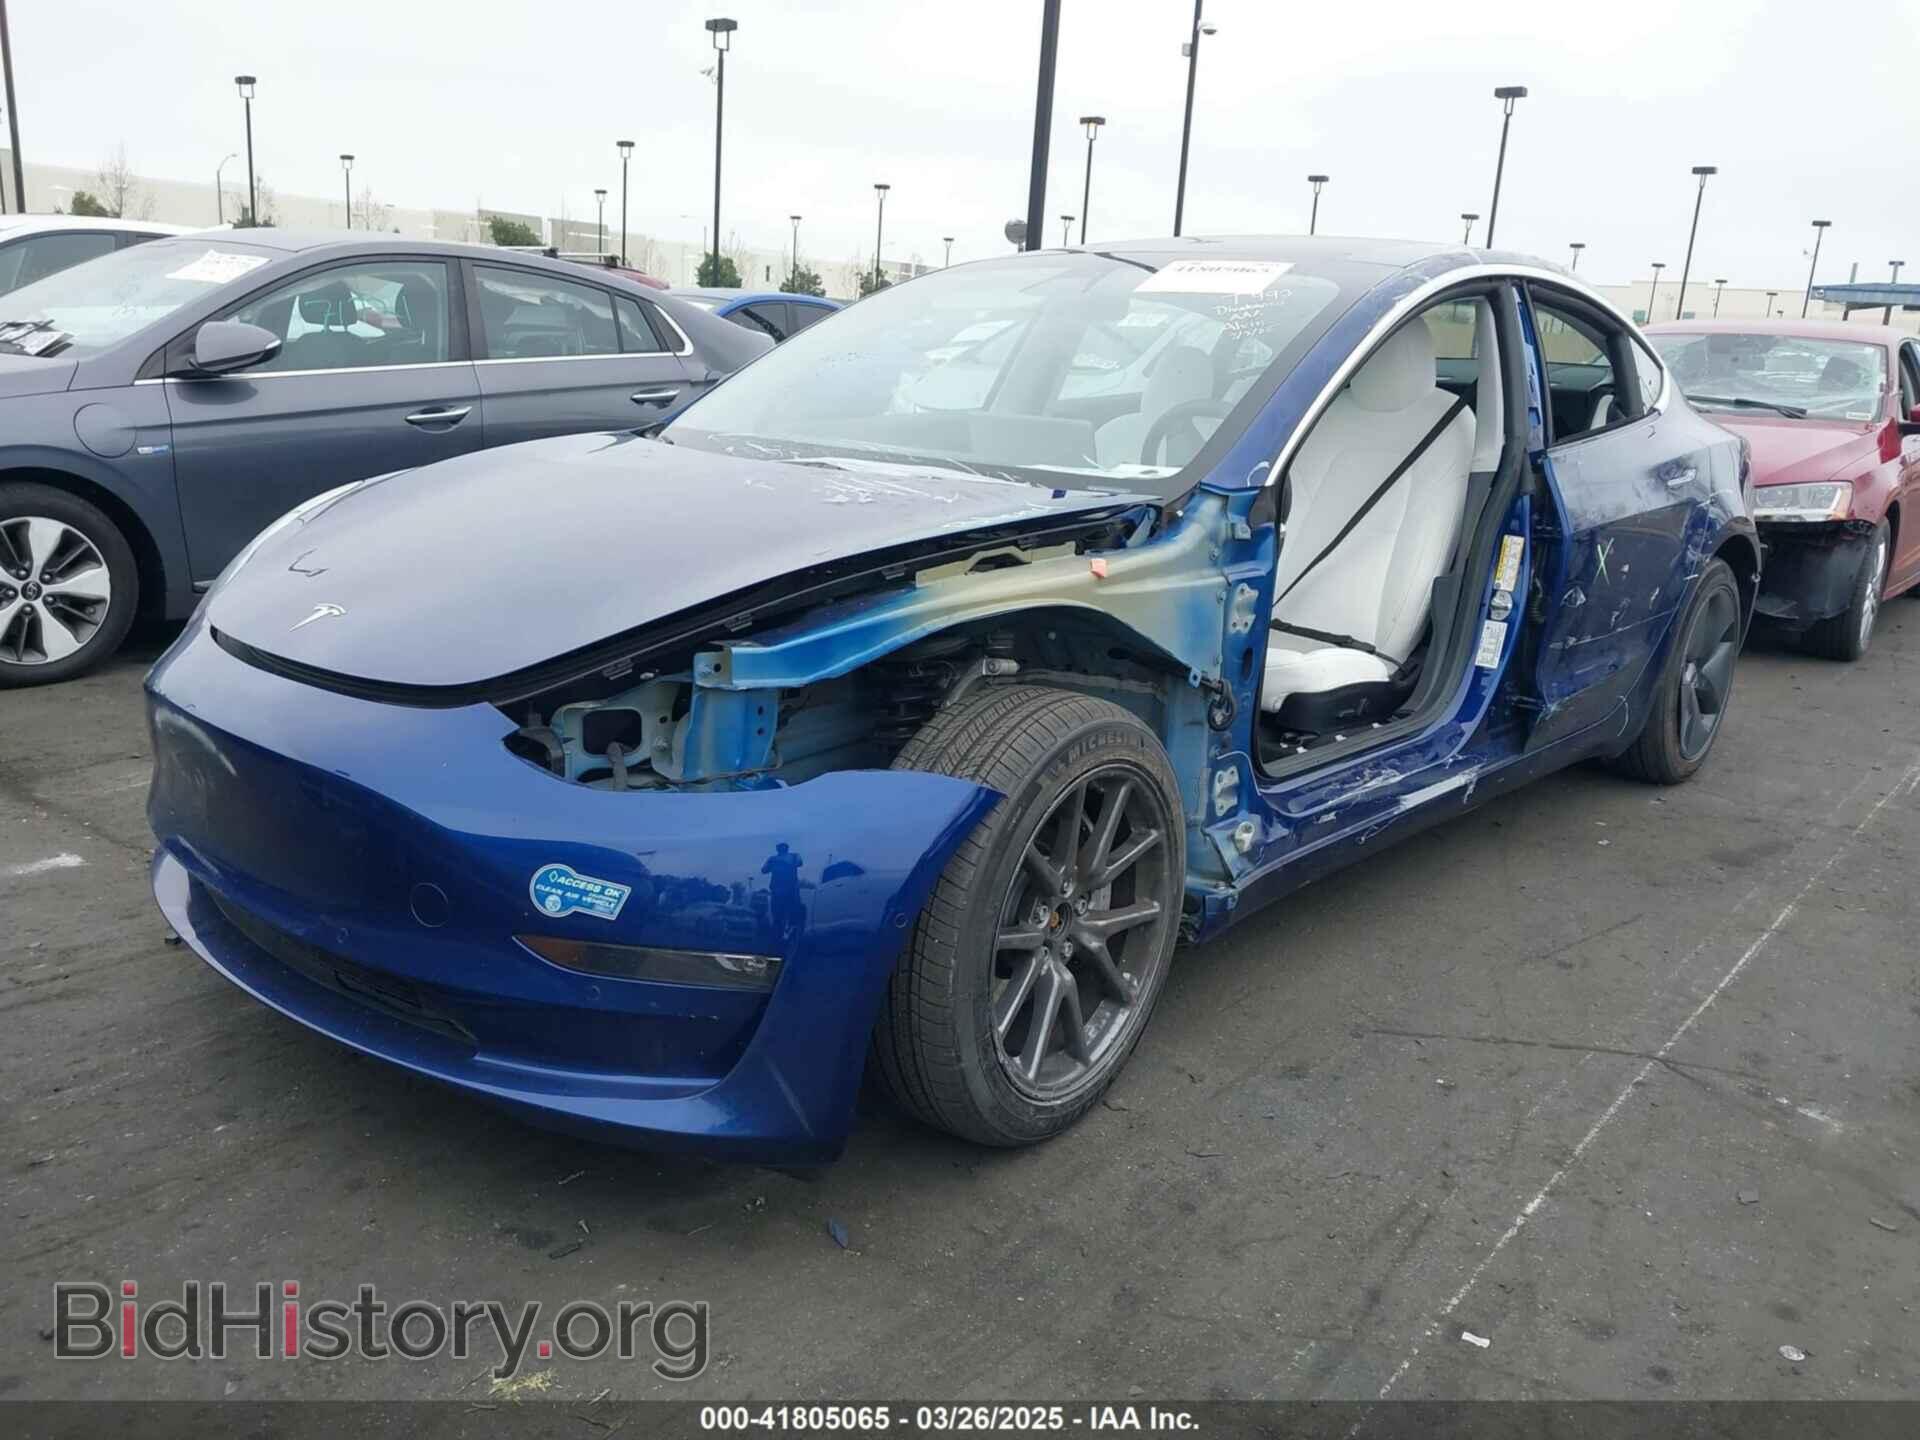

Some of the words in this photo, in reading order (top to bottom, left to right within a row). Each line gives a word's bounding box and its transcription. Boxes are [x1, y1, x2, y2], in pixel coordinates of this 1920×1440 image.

[535, 884, 564, 895] CLEAN
[557, 876, 601, 893] ACCESS
[604, 888, 622, 898] OK
